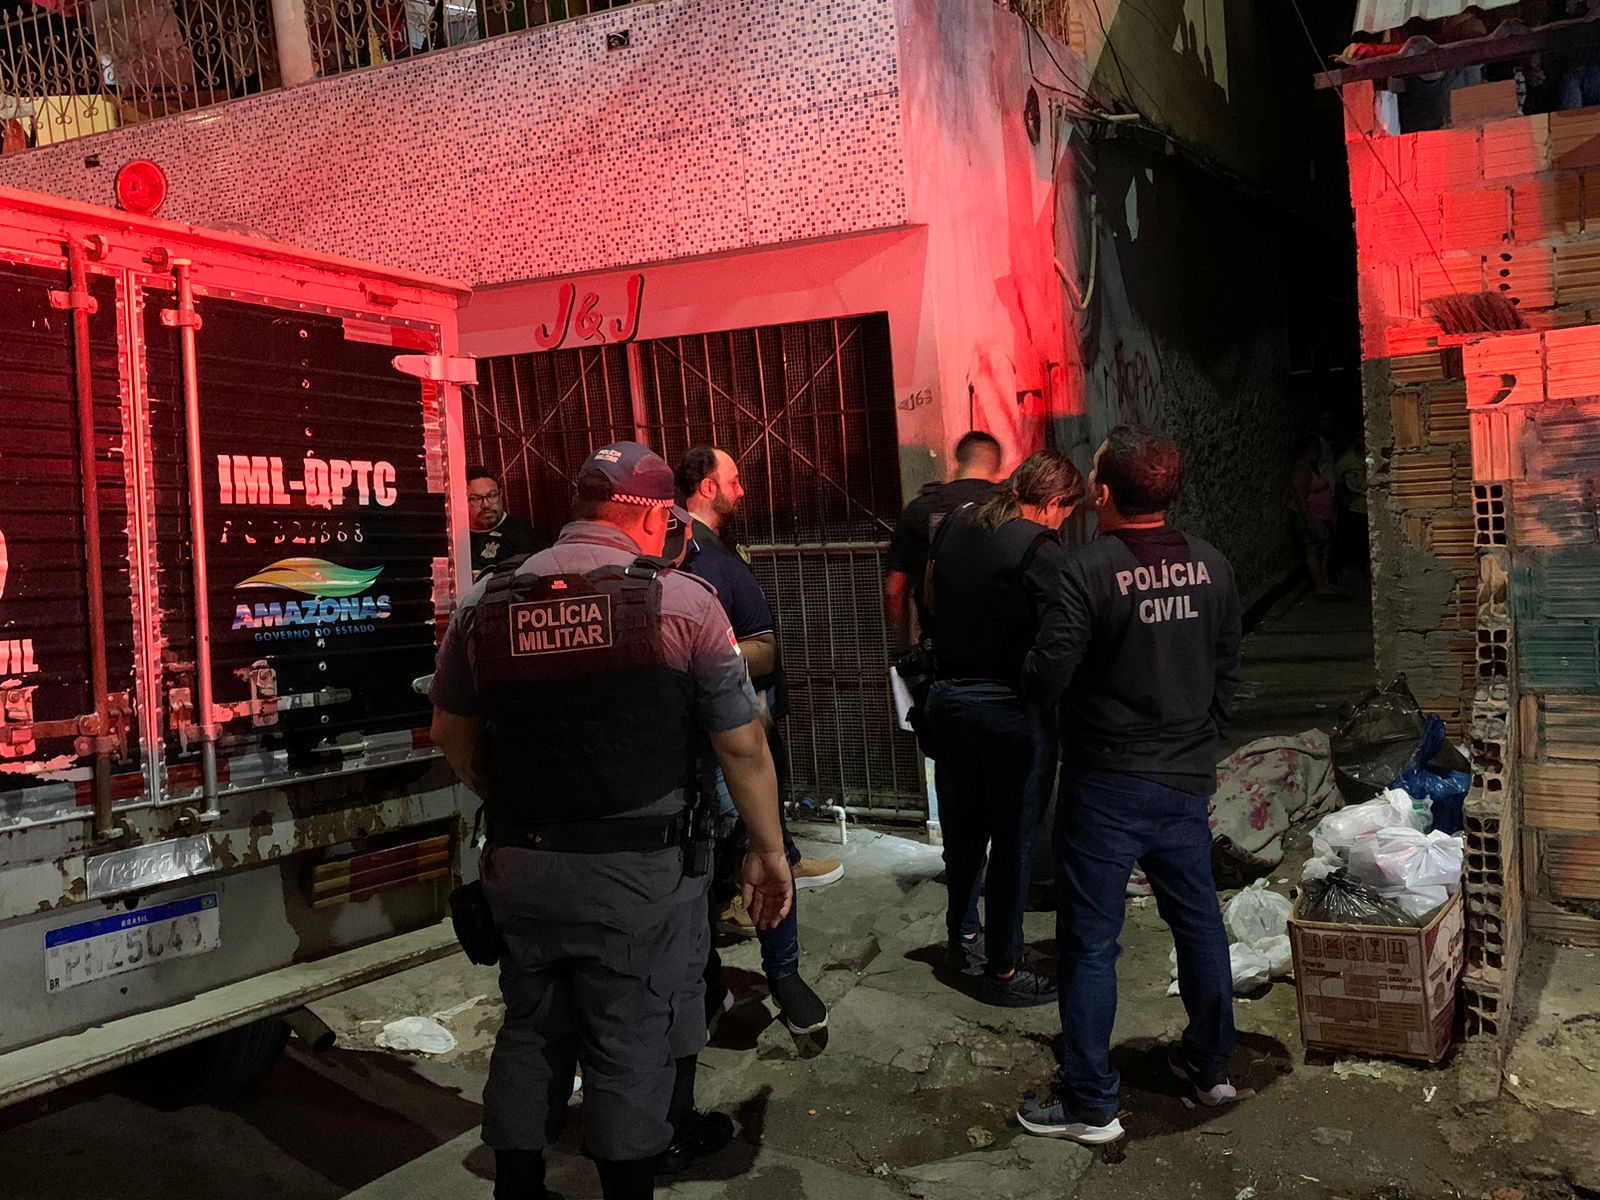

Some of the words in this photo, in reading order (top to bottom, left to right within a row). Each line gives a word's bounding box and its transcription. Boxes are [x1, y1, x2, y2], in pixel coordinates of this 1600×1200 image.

[1115, 559, 1212, 595] POLÍCIA
[231, 595, 392, 630] AMAZONAS
[517, 602, 602, 629] POLÍCIA
[1139, 595, 1198, 624] CIVIL
[254, 628, 310, 642] GOVERNO
[336, 624, 375, 636] ESTADO
[518, 625, 604, 651] MILITAR
[121, 915, 149, 927] BRASIL
[49, 978, 61, 990] BR
